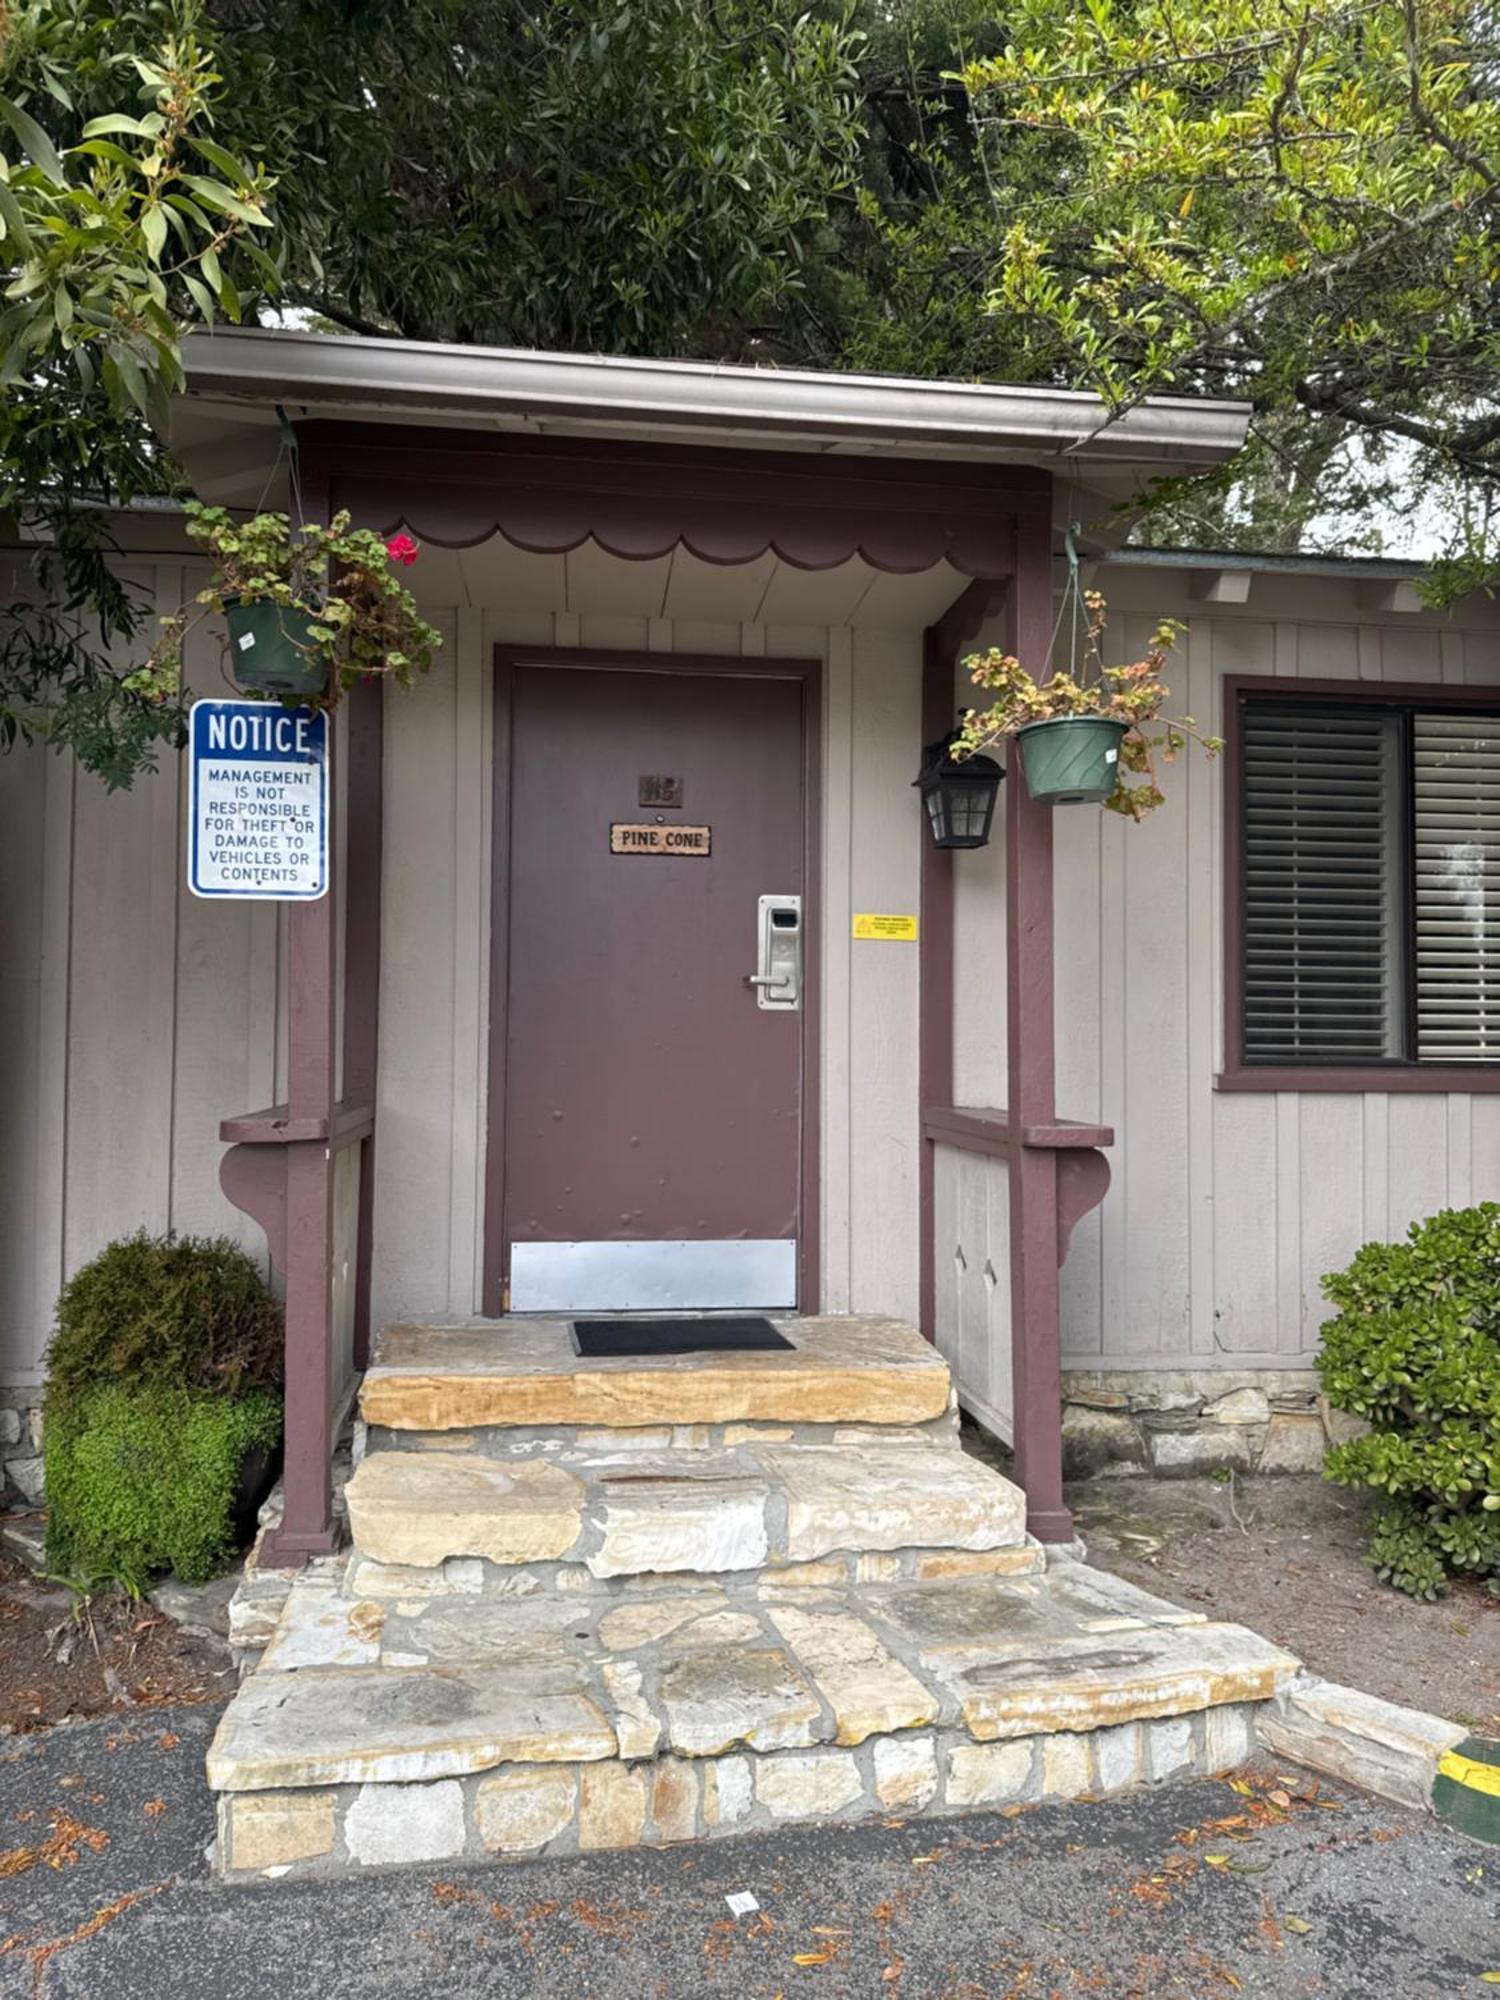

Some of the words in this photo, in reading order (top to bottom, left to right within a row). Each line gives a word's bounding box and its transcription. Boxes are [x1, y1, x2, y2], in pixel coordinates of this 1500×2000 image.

[208, 714, 311, 753] NOTICE
[208, 769, 312, 785] MANAGEMENT
[235, 787, 249, 798] IS
[256, 788, 285, 800] NOT
[209, 802, 310, 817] RESPONSIBLE
[205, 818, 234, 831] FOR
[242, 820, 287, 833] THEFT
[294, 821, 314, 833] OR
[215, 834, 278, 849] DAMAGE
[285, 837, 304, 849] TO
[622, 831, 659, 846] PINE
[665, 832, 703, 848] CONE
[209, 851, 282, 866] VEHICLES
[289, 853, 309, 865] OR
[221, 867, 298, 882] CONTENTS
